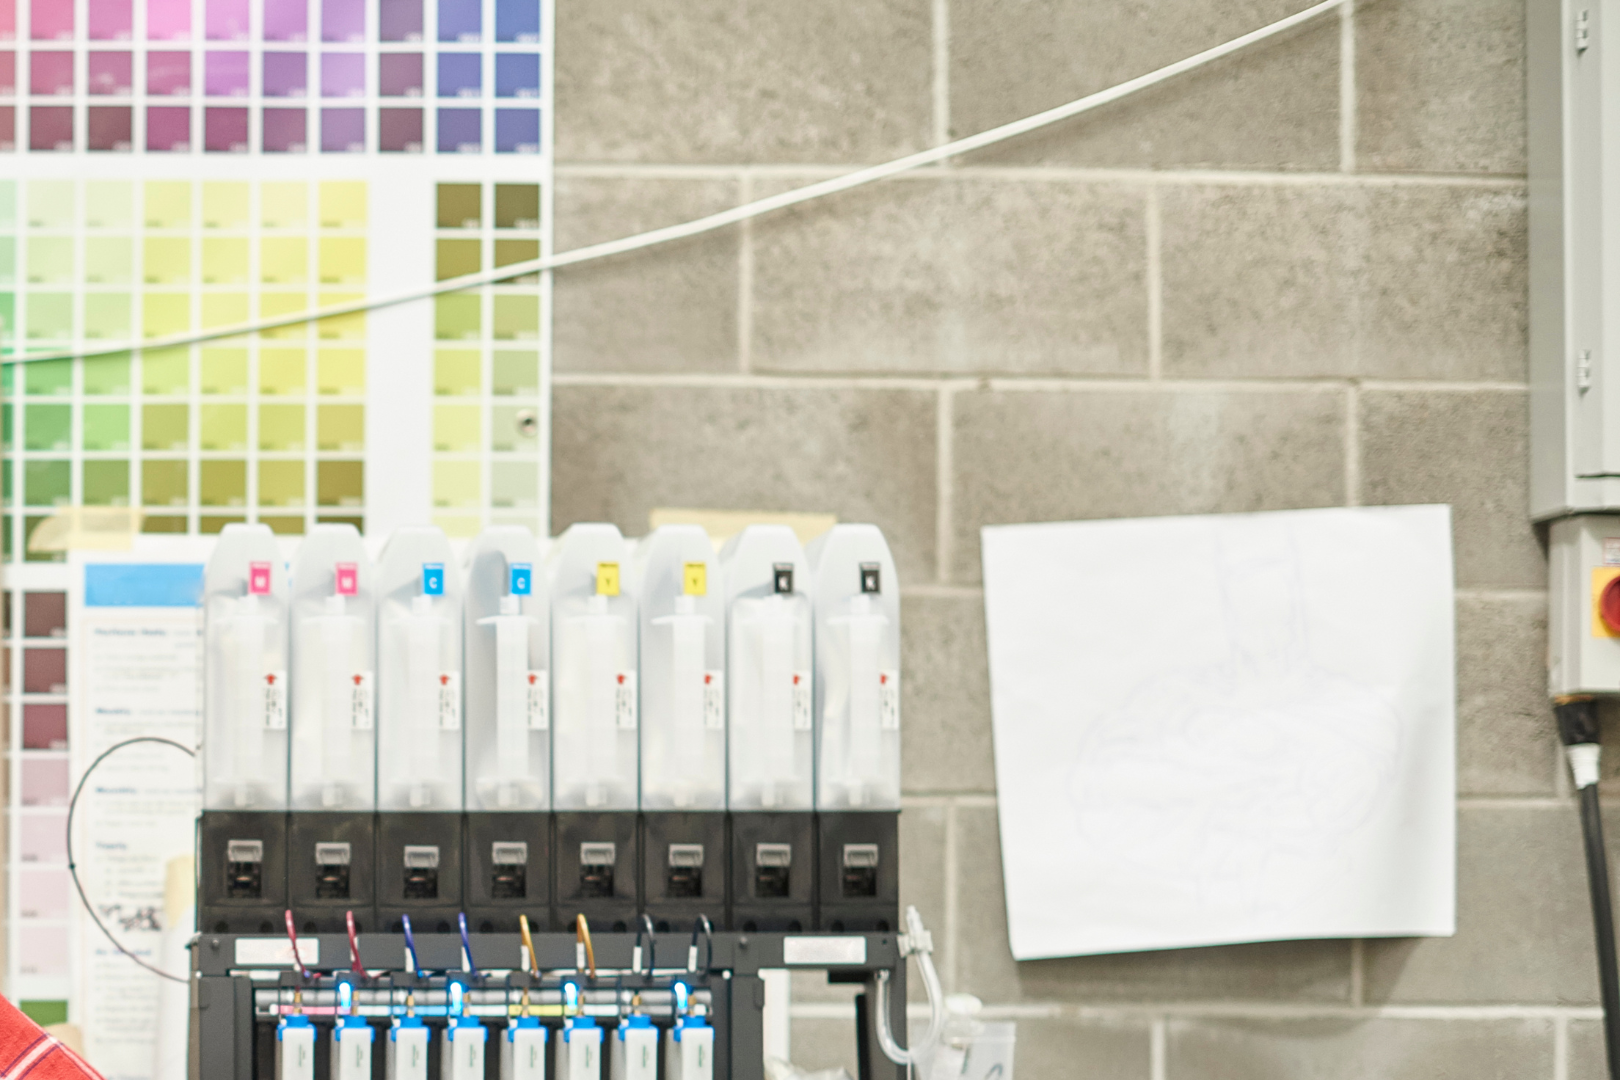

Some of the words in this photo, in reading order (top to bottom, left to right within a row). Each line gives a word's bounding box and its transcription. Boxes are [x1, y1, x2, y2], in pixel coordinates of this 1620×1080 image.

[254, 576, 267, 588] M
[341, 577, 354, 589] M
[428, 577, 438, 589] C
[516, 577, 526, 589] C
[778, 576, 789, 590] K
[865, 576, 876, 590] K
